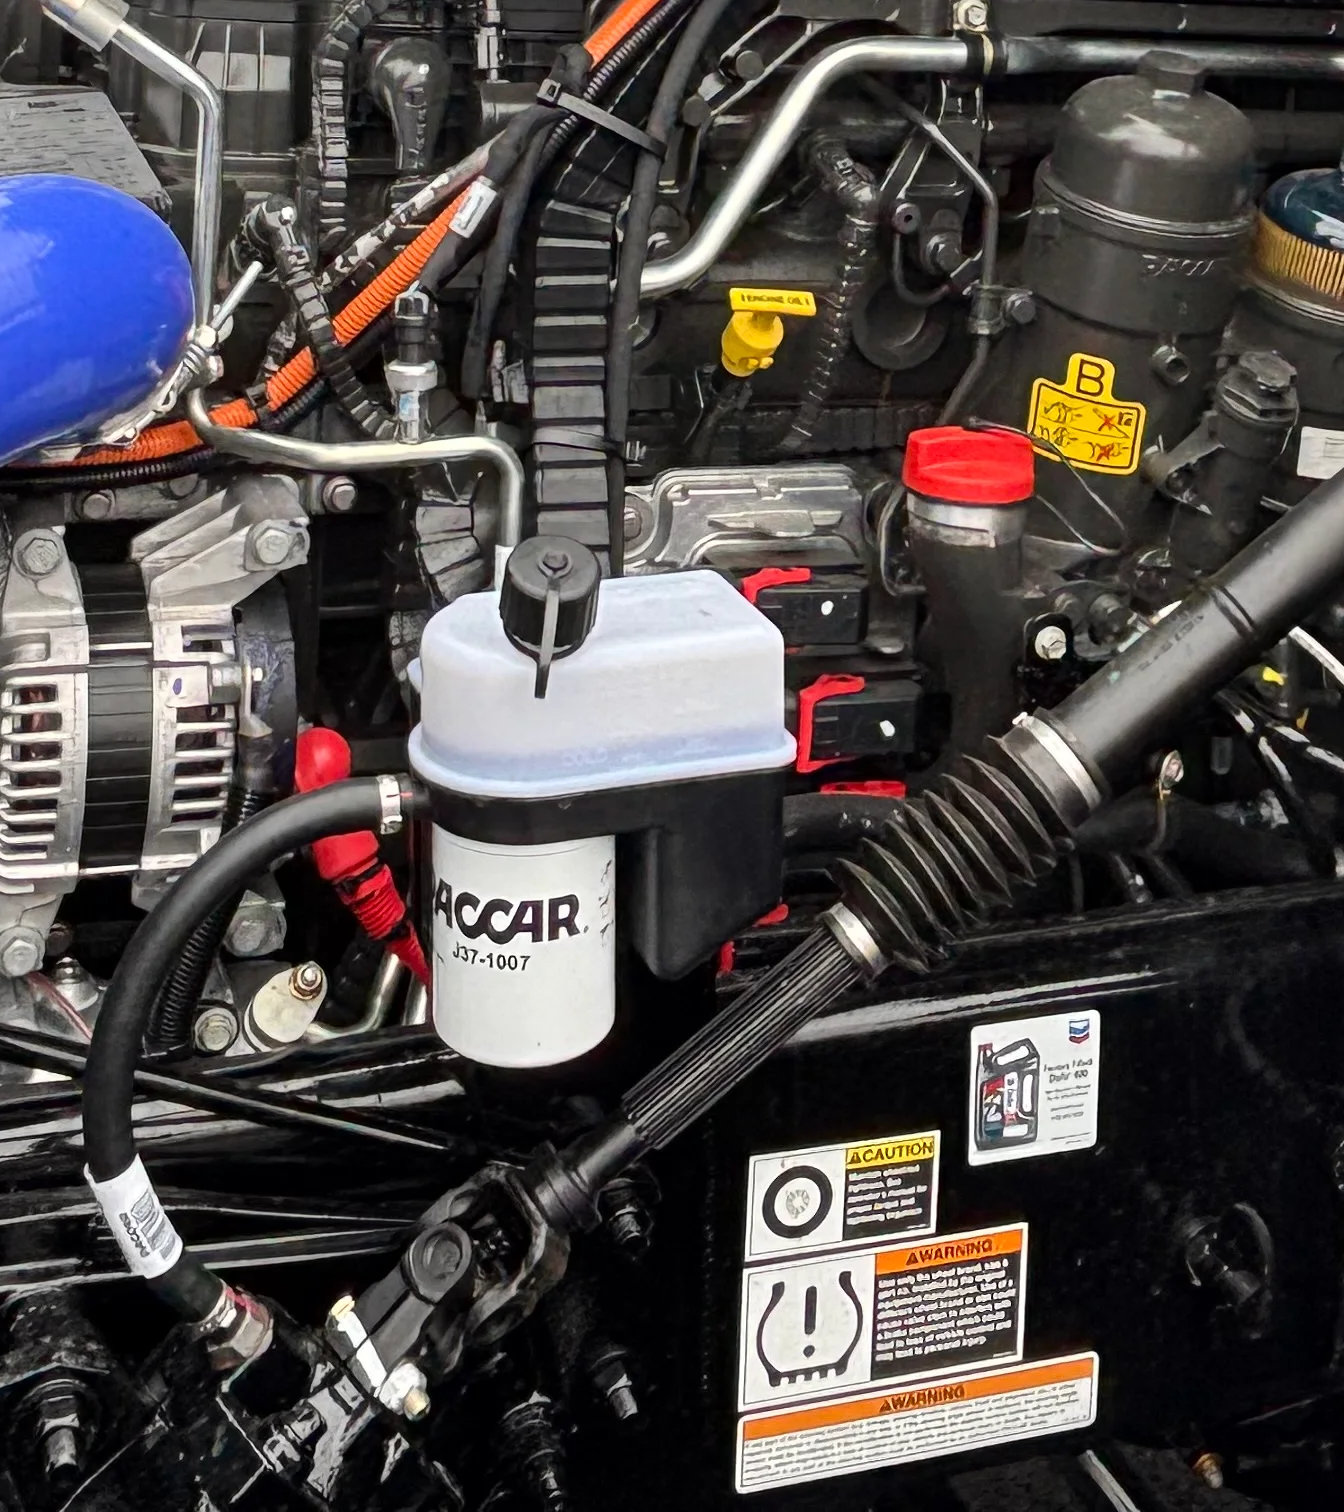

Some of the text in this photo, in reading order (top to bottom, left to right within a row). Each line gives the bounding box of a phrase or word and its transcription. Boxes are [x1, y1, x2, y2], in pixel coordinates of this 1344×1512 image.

[1076, 358, 1105, 397] B
[452, 941, 531, 971] J37-1007
[862, 1141, 934, 1163] CAUTION
[919, 1238, 993, 1263] WARNING
[888, 1384, 966, 1411] WARNING
